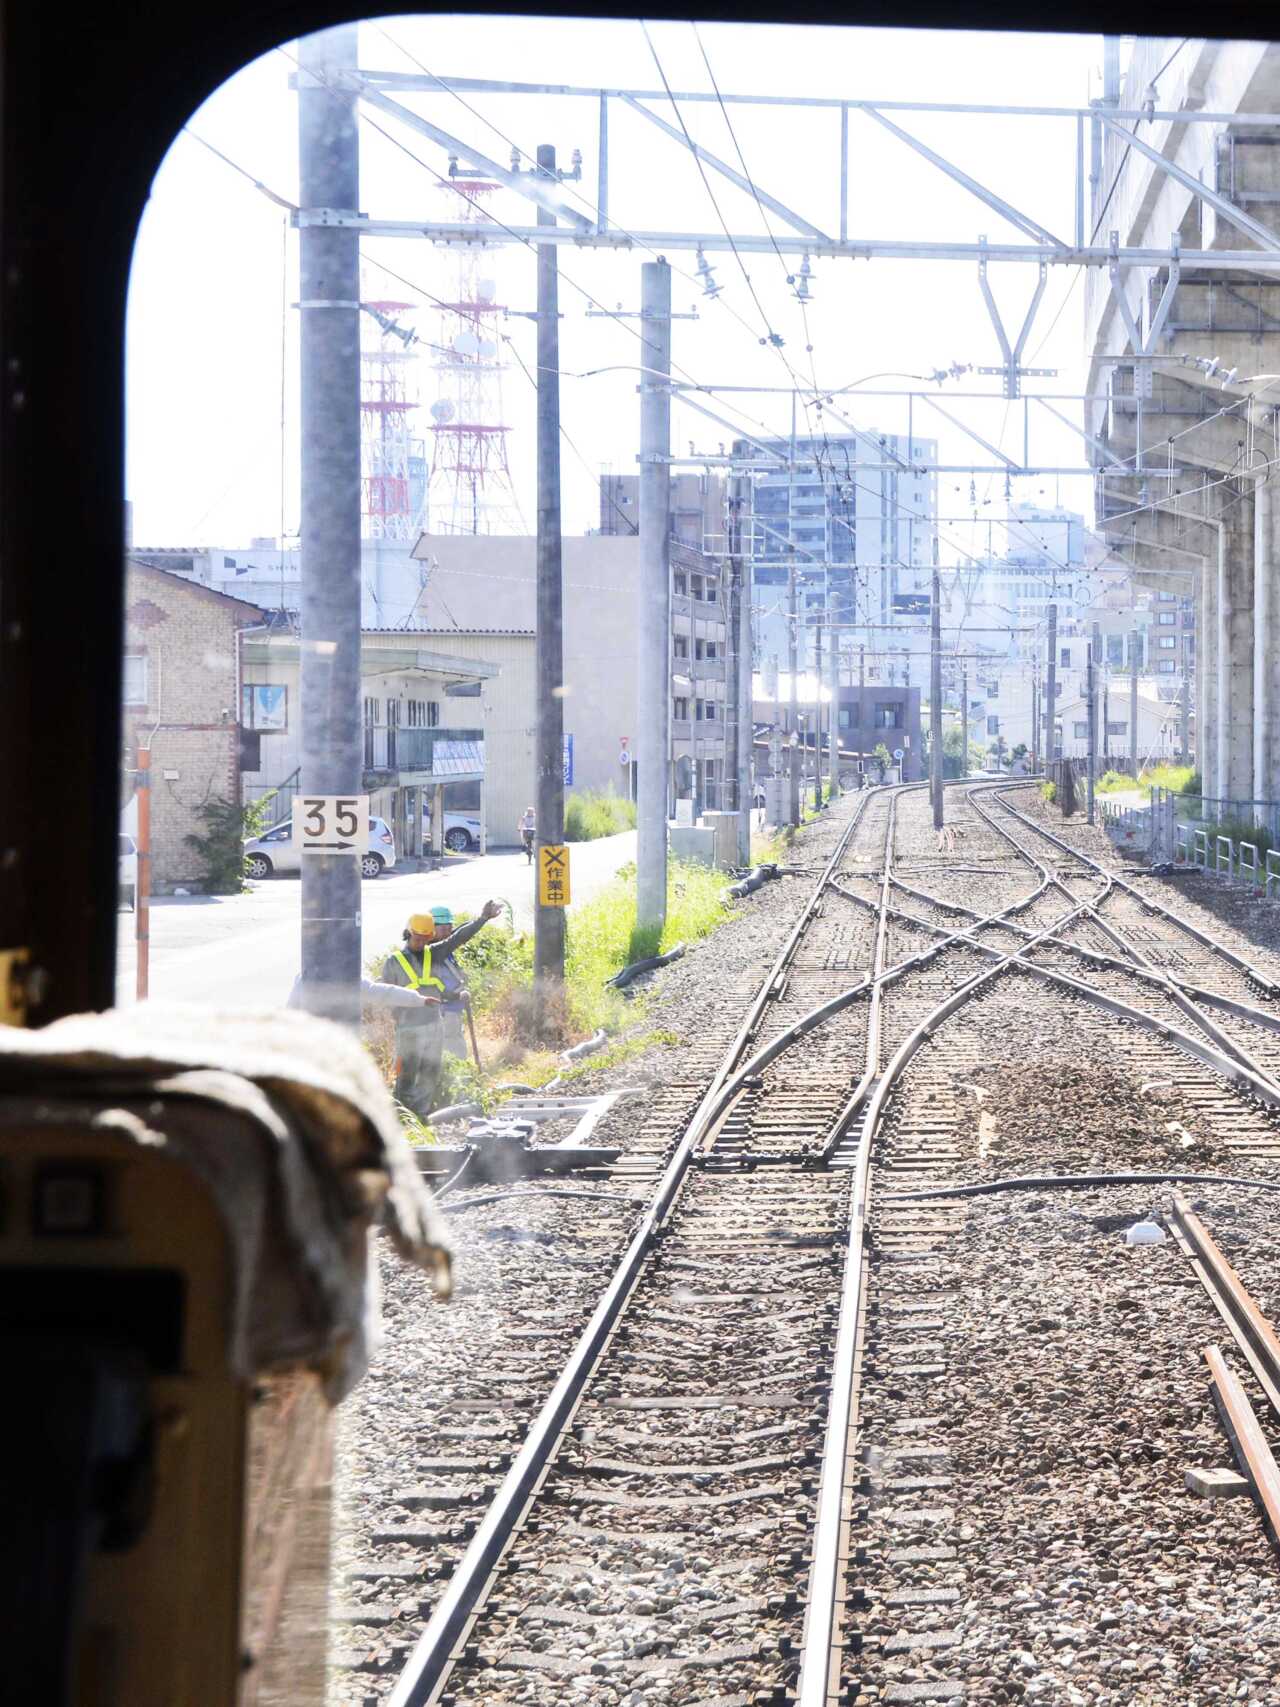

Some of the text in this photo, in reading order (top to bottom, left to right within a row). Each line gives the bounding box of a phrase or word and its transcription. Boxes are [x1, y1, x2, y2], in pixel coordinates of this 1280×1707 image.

[303, 799, 359, 838] 35
[547, 867, 564, 904] 作業中
